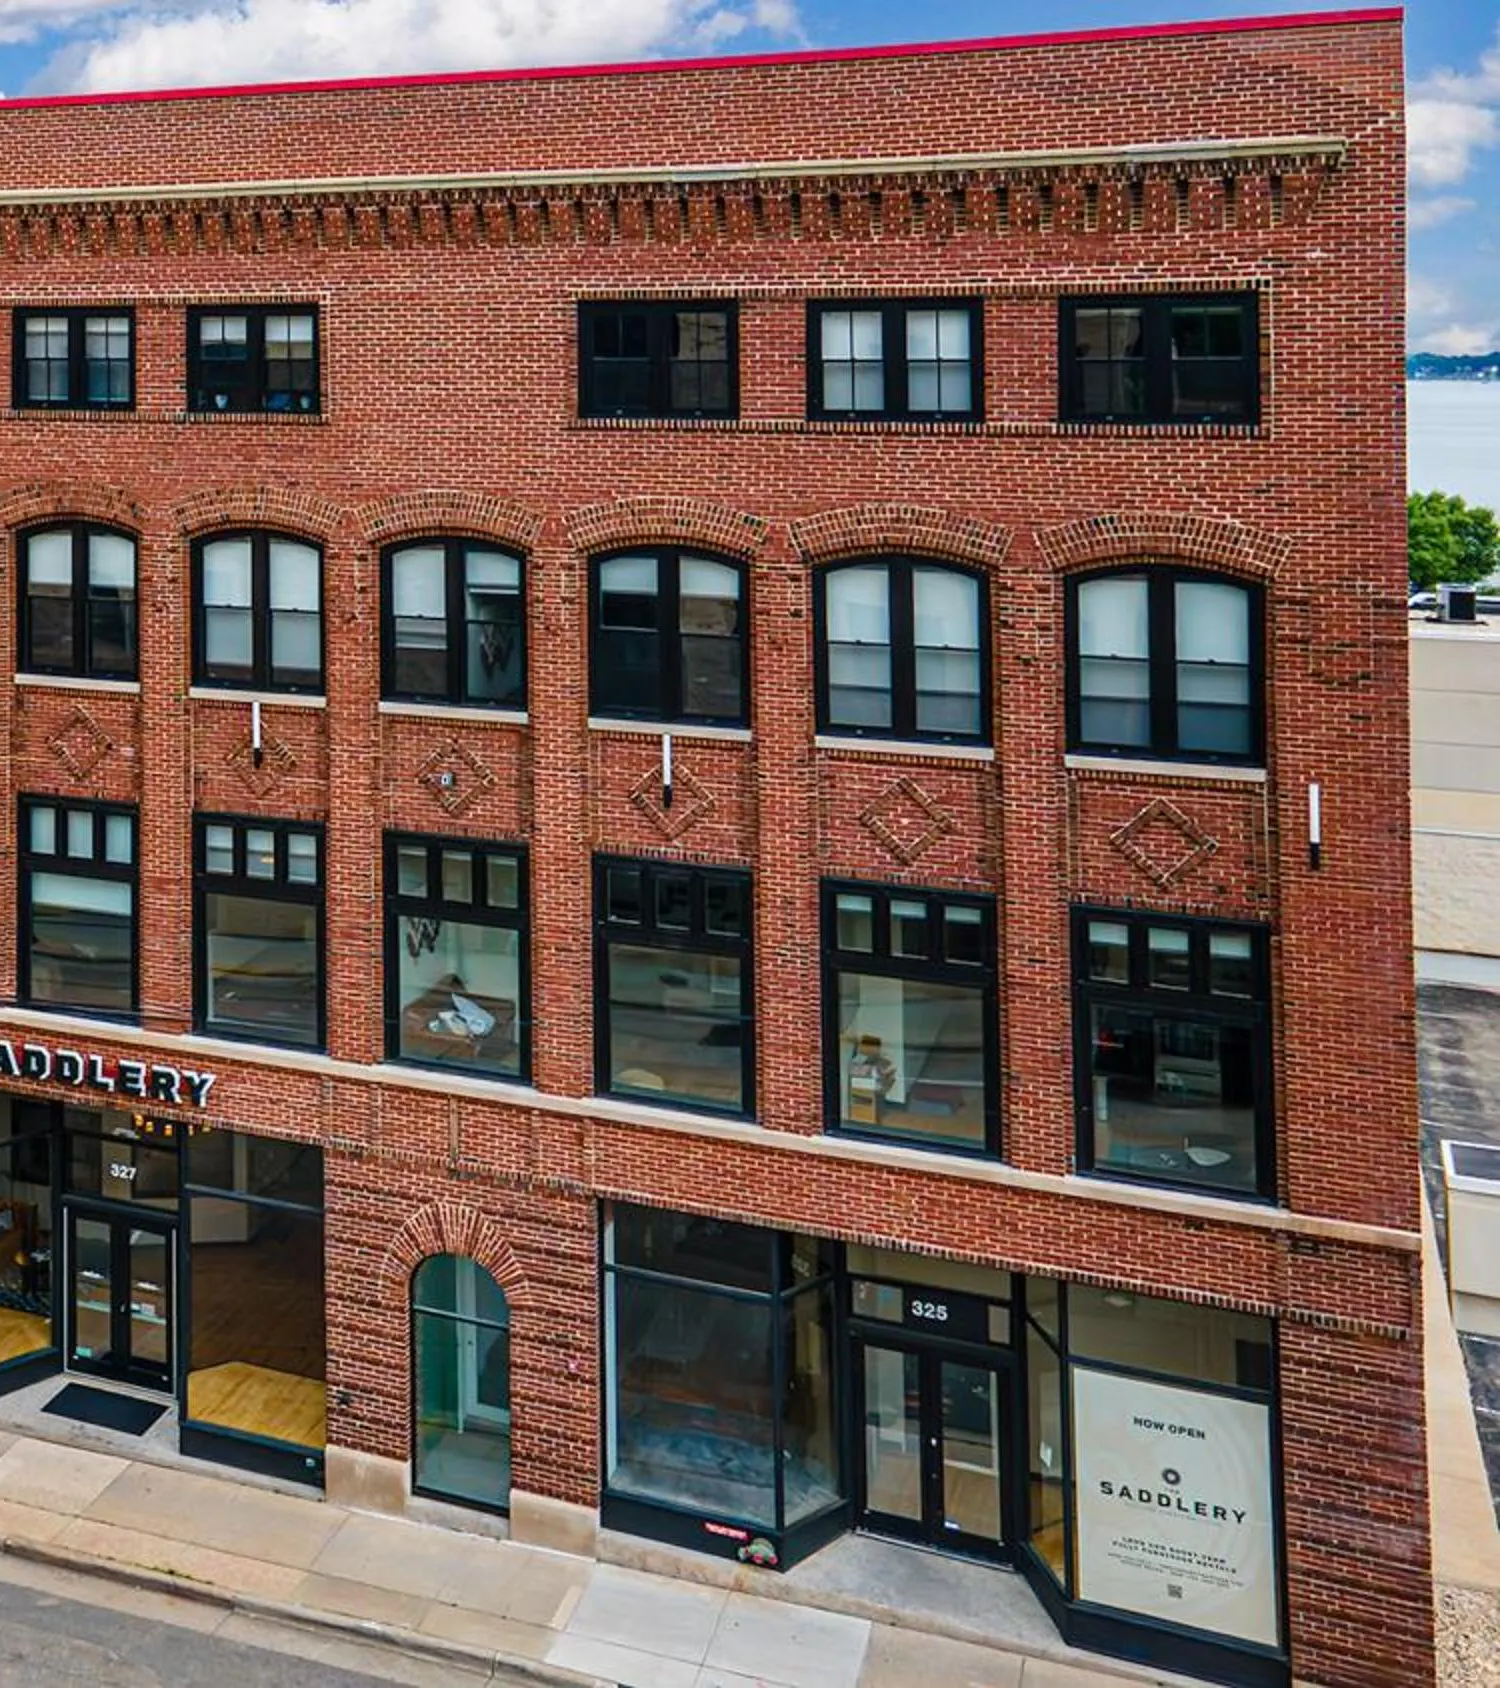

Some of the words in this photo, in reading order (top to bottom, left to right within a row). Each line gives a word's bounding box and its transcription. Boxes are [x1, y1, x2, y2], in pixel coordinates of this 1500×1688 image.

[109, 1163, 137, 1180] 327
[911, 1300, 948, 1321] 325
[1133, 1416, 1165, 1431] NOW
[1167, 1424, 1206, 1440] OPEN
[1100, 1481, 1247, 1524] SADDLERY
